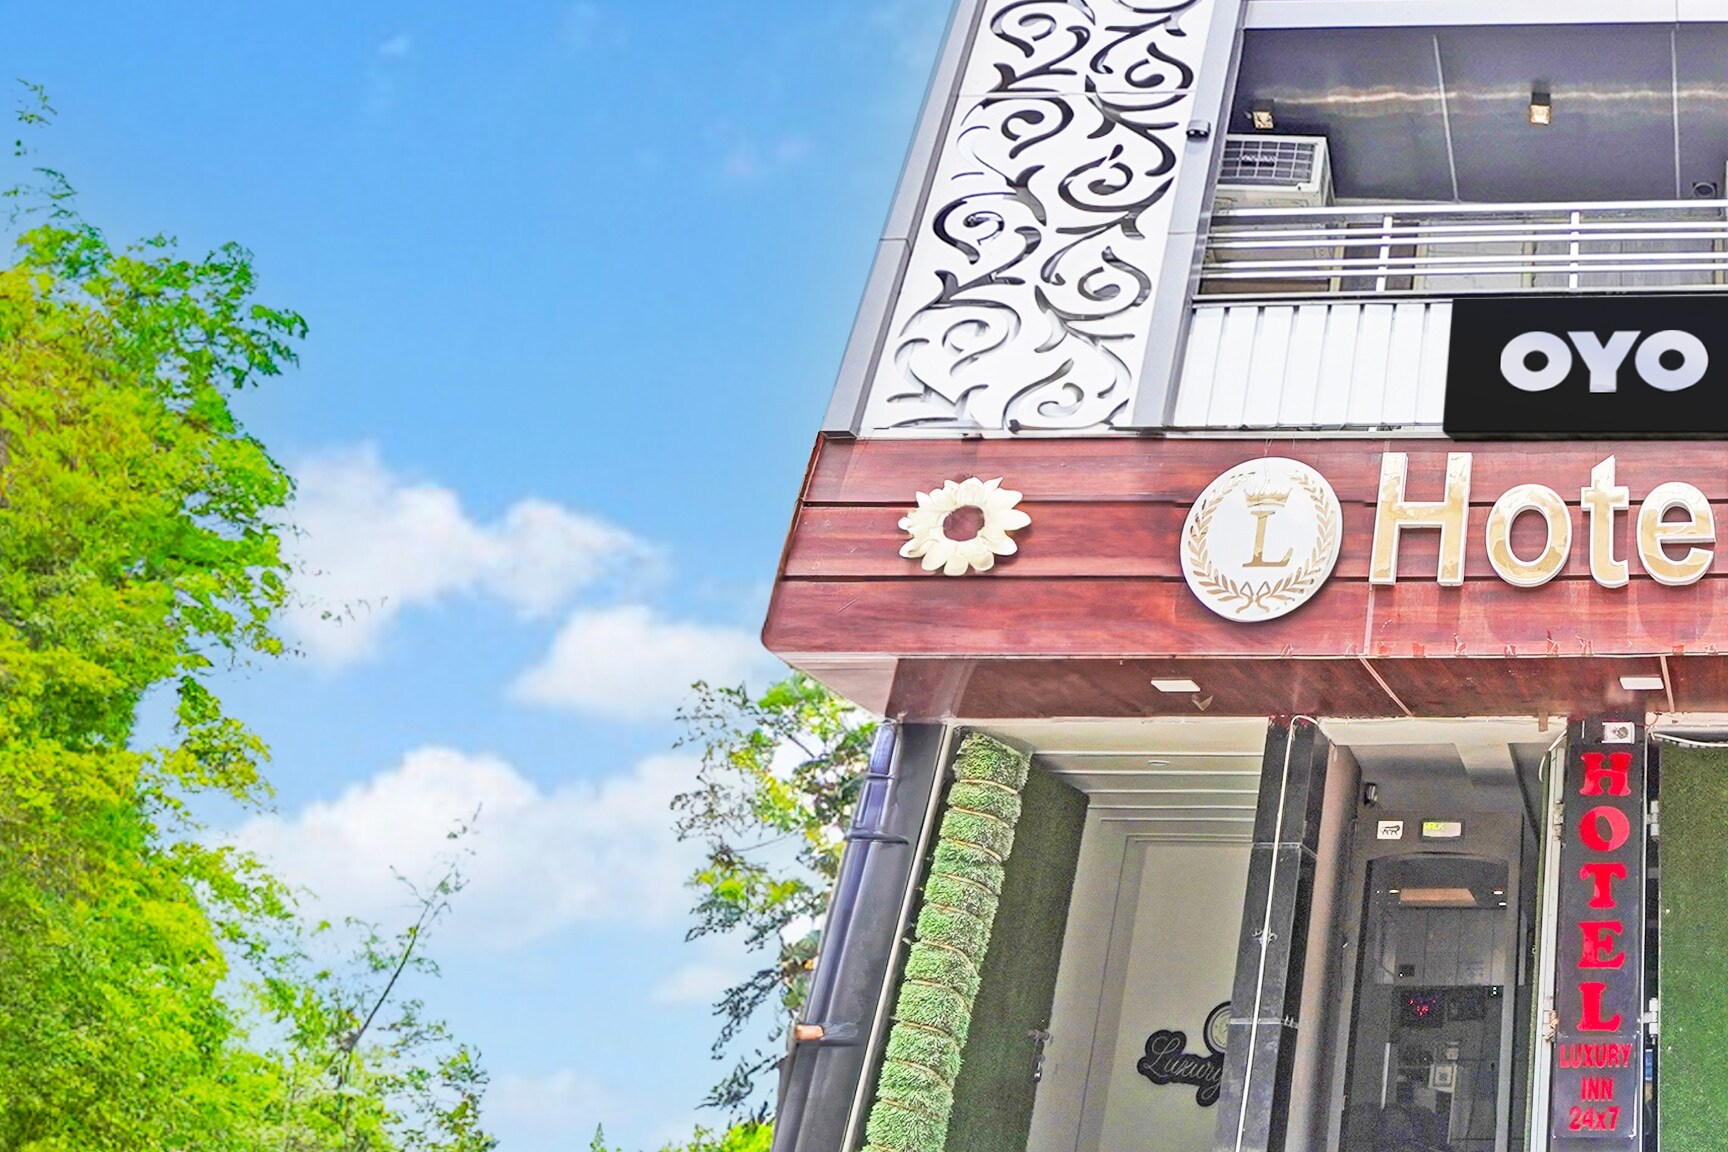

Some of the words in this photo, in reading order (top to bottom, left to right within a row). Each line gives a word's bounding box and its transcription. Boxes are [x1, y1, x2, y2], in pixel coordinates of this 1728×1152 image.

[1500, 329, 1709, 392] OYO
[1242, 509, 1295, 568] L
[1576, 752, 1633, 1033] HOTEL
[1559, 1043, 1633, 1069] LUXURY
[1581, 1077, 1614, 1102] INN
[1569, 1105, 1620, 1132] 24x7
